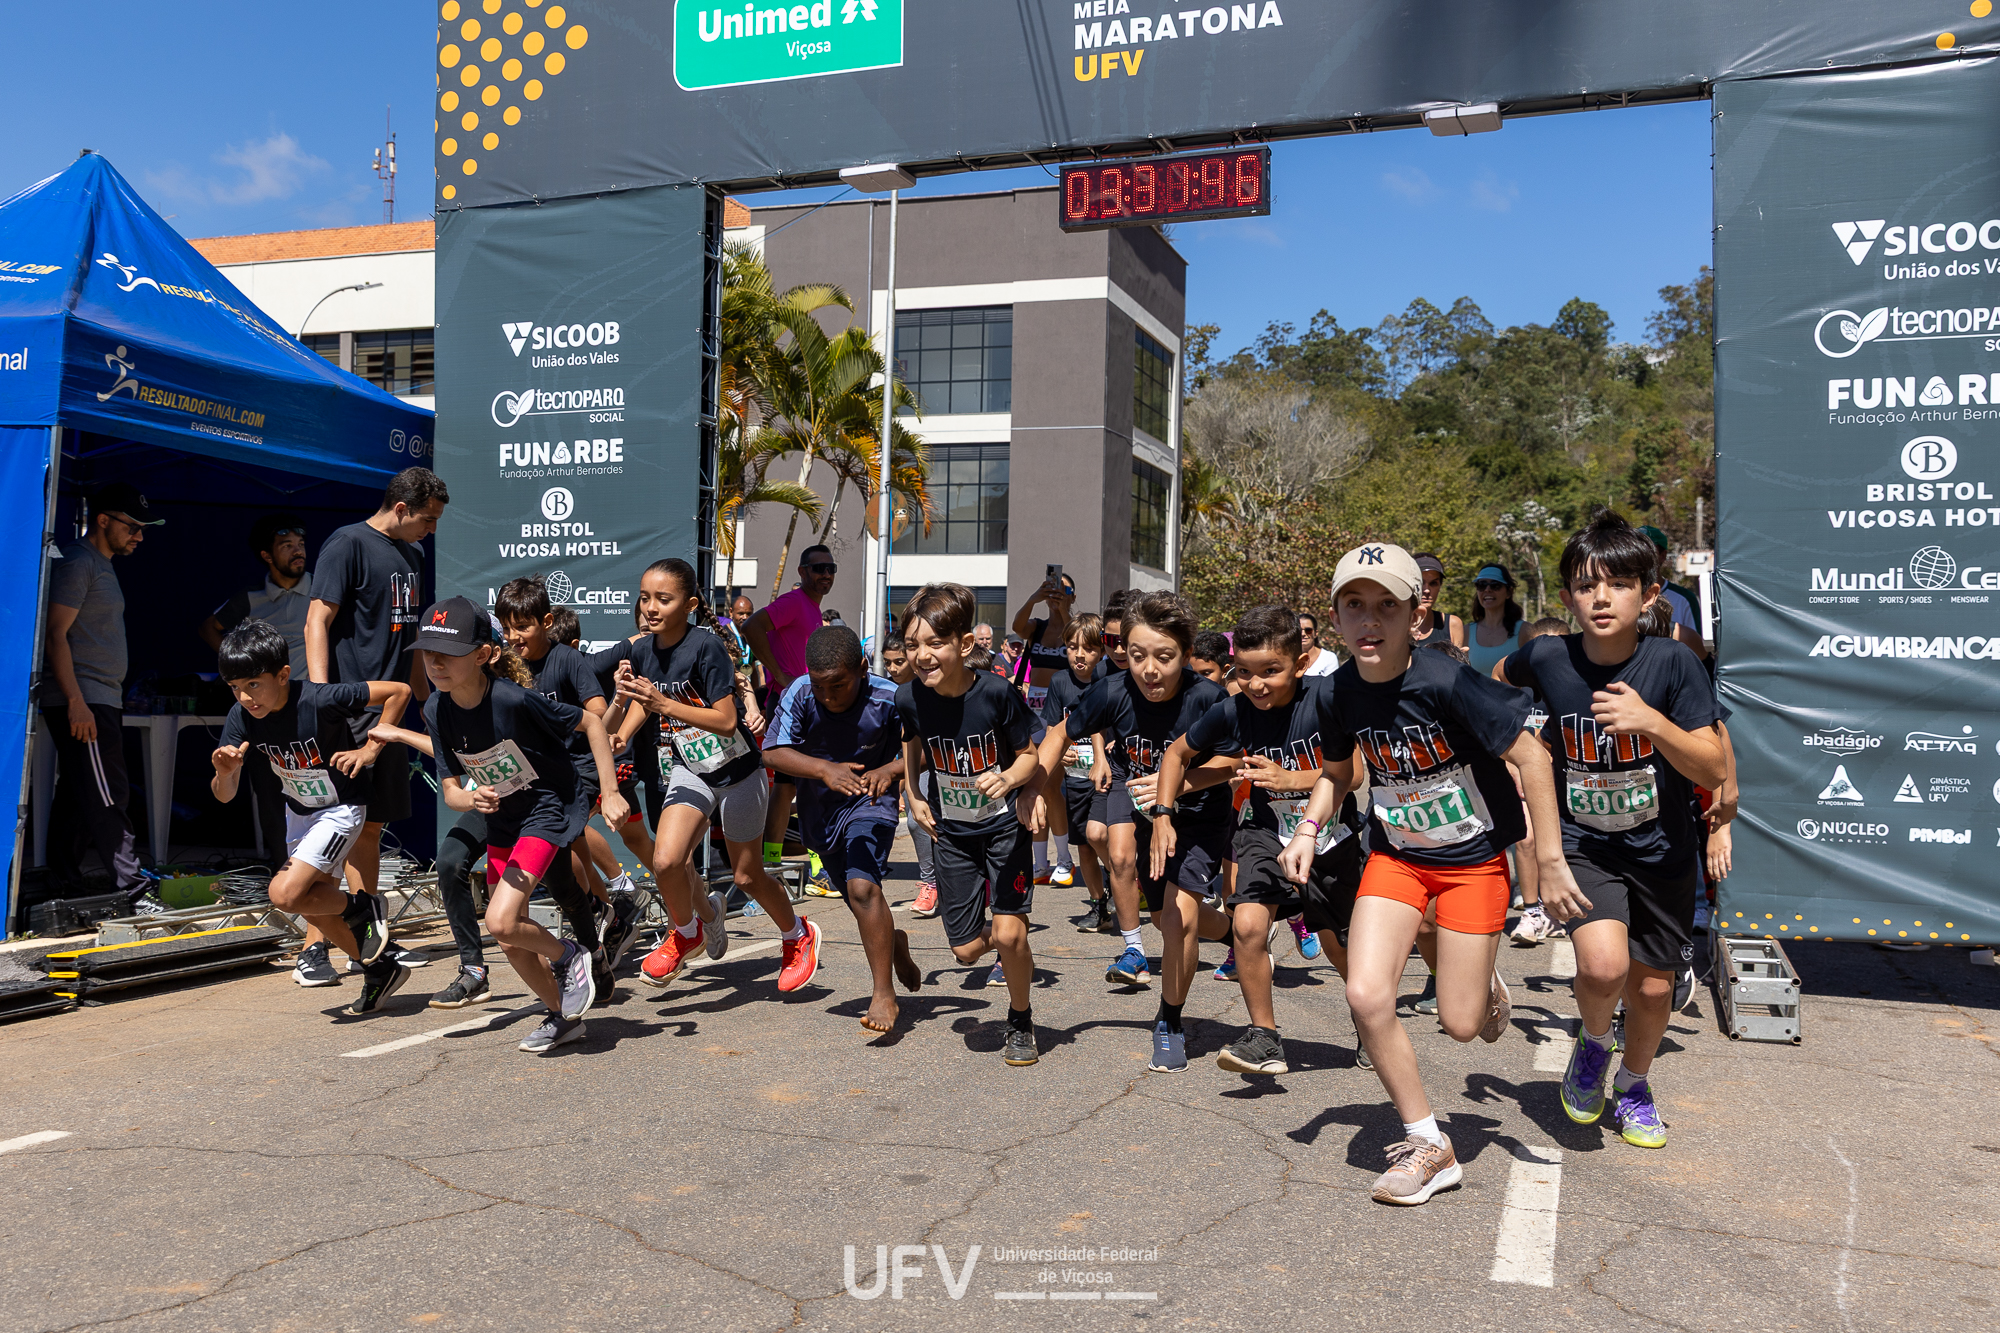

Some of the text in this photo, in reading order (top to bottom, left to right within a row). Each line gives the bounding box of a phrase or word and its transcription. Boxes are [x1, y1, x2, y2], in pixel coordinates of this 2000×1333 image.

[1074, 0, 1130, 19] MEIA
[699, 0, 831, 41] Unimed
[1074, 1, 1283, 50] MARATONA
[786, 40, 831, 60] Viçosa
[1074, 49, 1144, 82] UFV
[1068, 155, 1259, 217] 03:31:46
[1884, 258, 2000, 280] União dos V
[532, 321, 620, 350] SICOOB
[532, 352, 619, 368] União dos Vales
[139, 386, 265, 428] RESULTADOFINAL.COM
[1829, 407, 2000, 426] Fundação Arthur Bern
[589, 413, 624, 423] SOCIAL
[191, 422, 263, 445] EVENTOS ESPORTIVOS
[500, 438, 623, 467] FUNARBE
[500, 465, 623, 480] Fundação Arthur Bernardes
[1867, 482, 1993, 502] BRISTOL
[1828, 509, 1935, 528] VIÇOSA
[521, 522, 594, 538] BRISTOL
[499, 541, 621, 559] VIÇOSA HOTEL
[1812, 567, 2000, 589] Mundi Ce
[575, 587, 629, 604] Center
[1809, 596, 1839, 604] CONCEPT
[1840, 596, 1860, 604] STORE
[1879, 596, 1903, 604] SPORTS
[1910, 596, 1932, 604] SHOES
[1950, 596, 1989, 604] MENSWEAR
[1930, 777, 1970, 786] GINÁSTICA
[1930, 785, 1968, 794] ARTÍSTICA
[944, 787, 990, 810] 307
[1573, 786, 1650, 814] 3006
[1929, 793, 1948, 803] UFV
[1390, 791, 1467, 832] 3011
[1822, 821, 1889, 836] NÚCLEO
